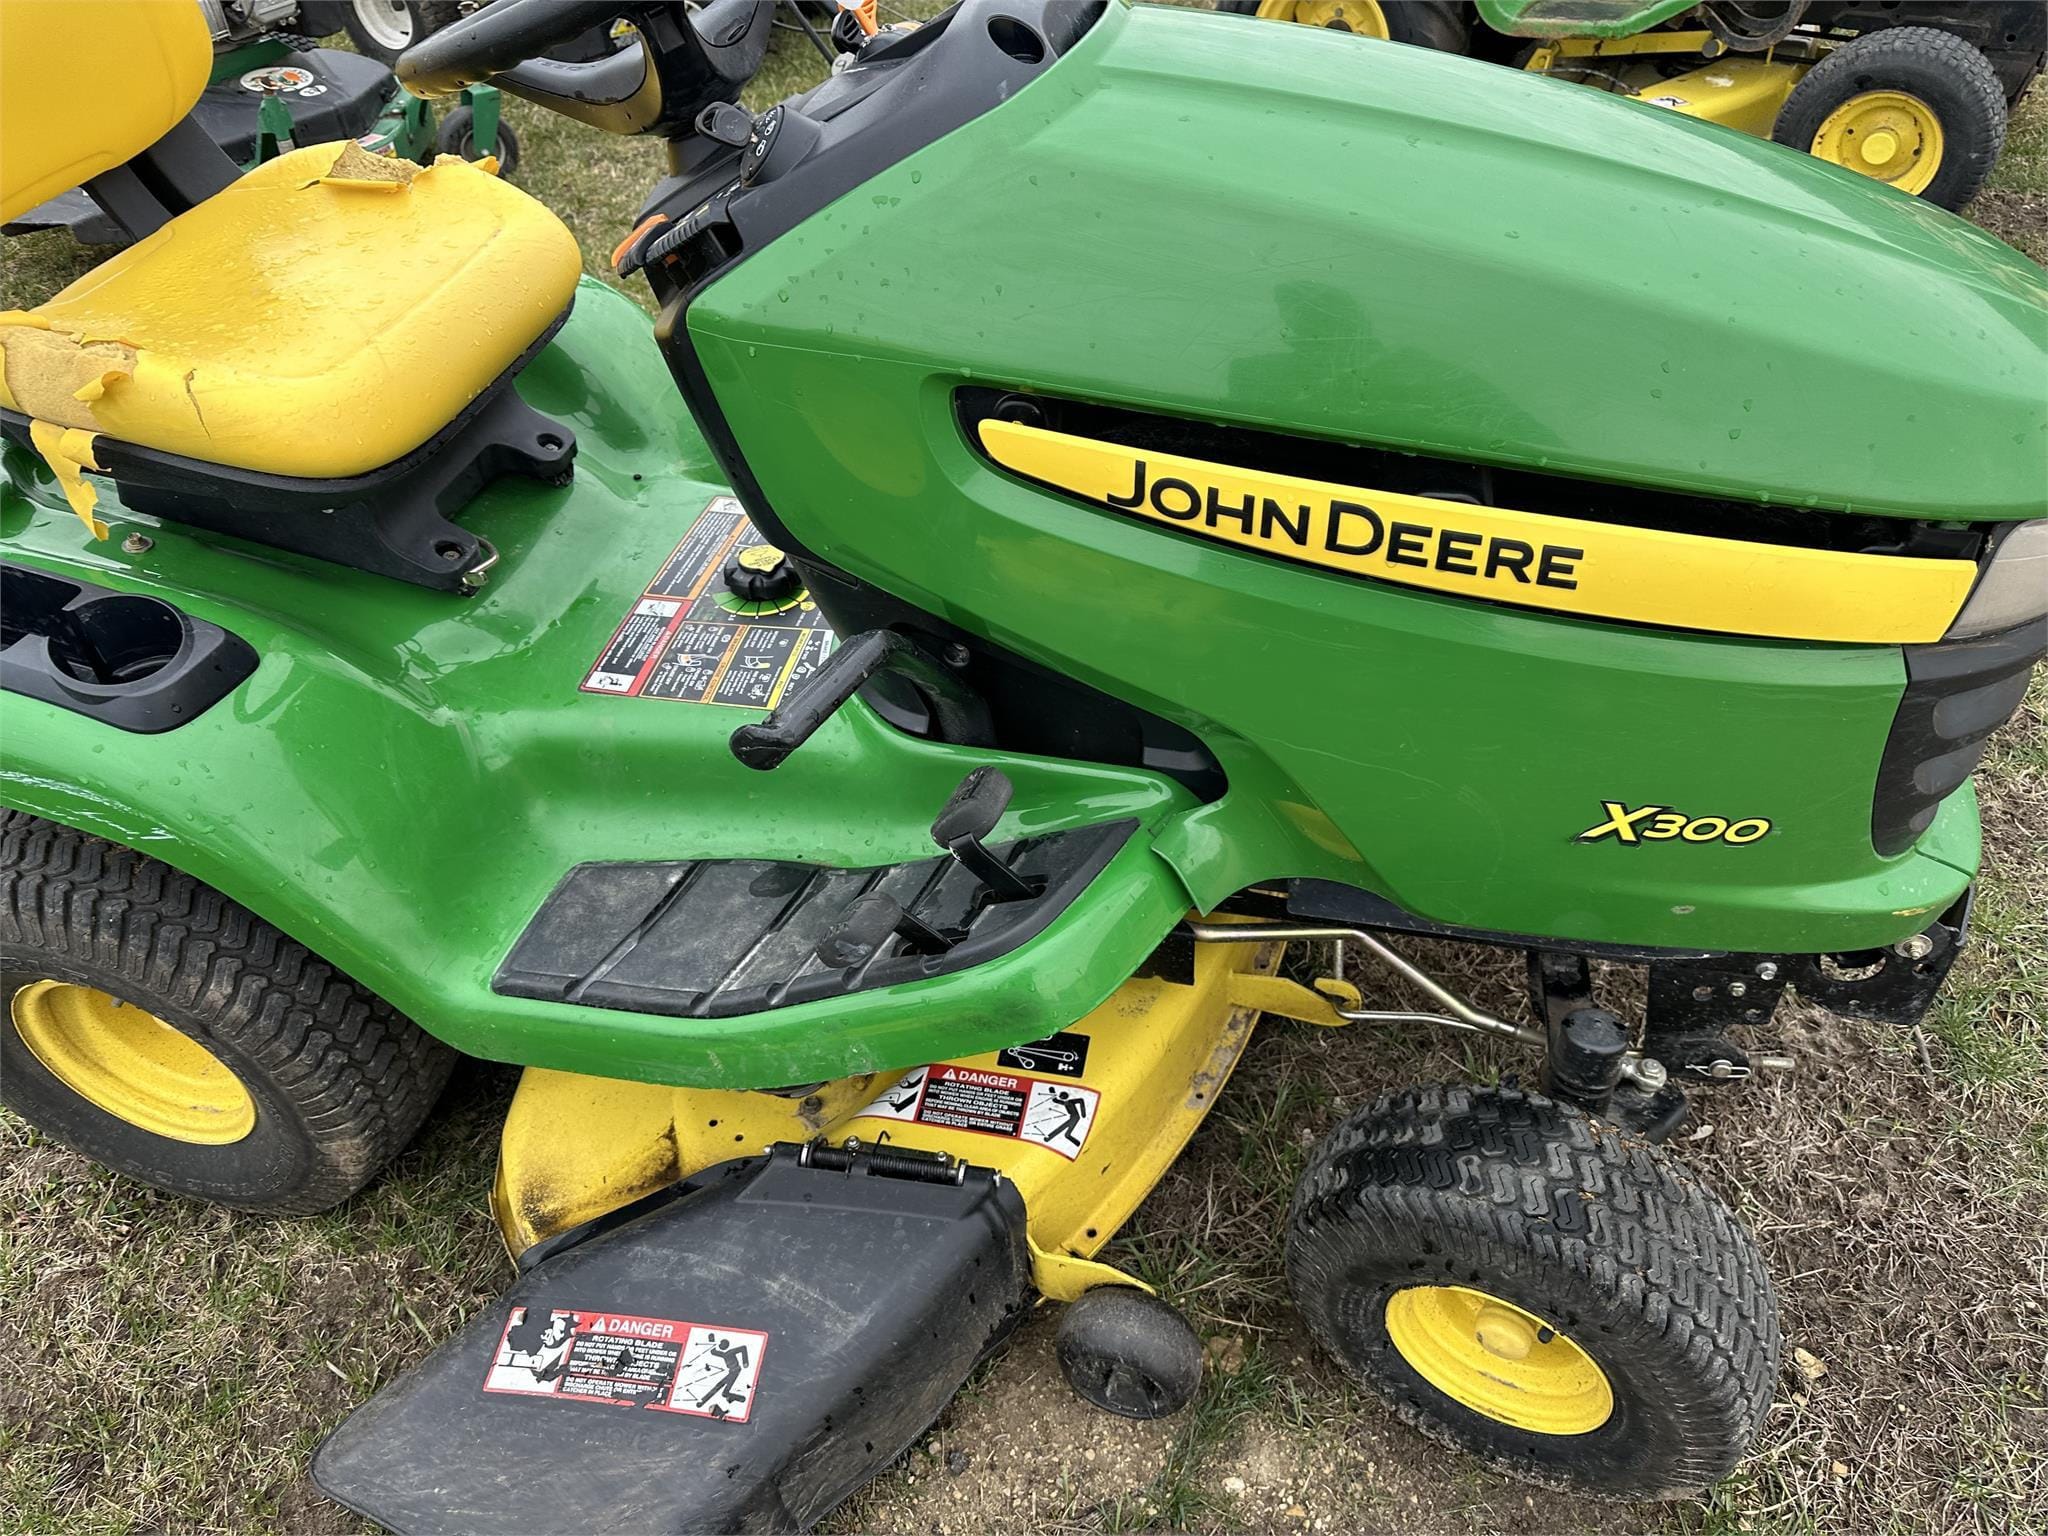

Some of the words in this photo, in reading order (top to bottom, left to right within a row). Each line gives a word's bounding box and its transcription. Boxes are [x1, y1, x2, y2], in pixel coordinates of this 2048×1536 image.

[1107, 460, 1311, 546] JOHN
[1324, 500, 1585, 590] DEERE
[650, 635, 669, 659] DANGER
[1577, 801, 1772, 846] X300
[944, 1082, 982, 1091] ROTATING
[959, 1071, 1017, 1088] DANGER
[939, 1095, 972, 1104] THROWN
[973, 1100, 1008, 1110] OBJECTS
[608, 1319, 673, 1338] DANGER
[592, 1335, 634, 1345] ROTATING
[634, 1340, 664, 1348] BLADE
